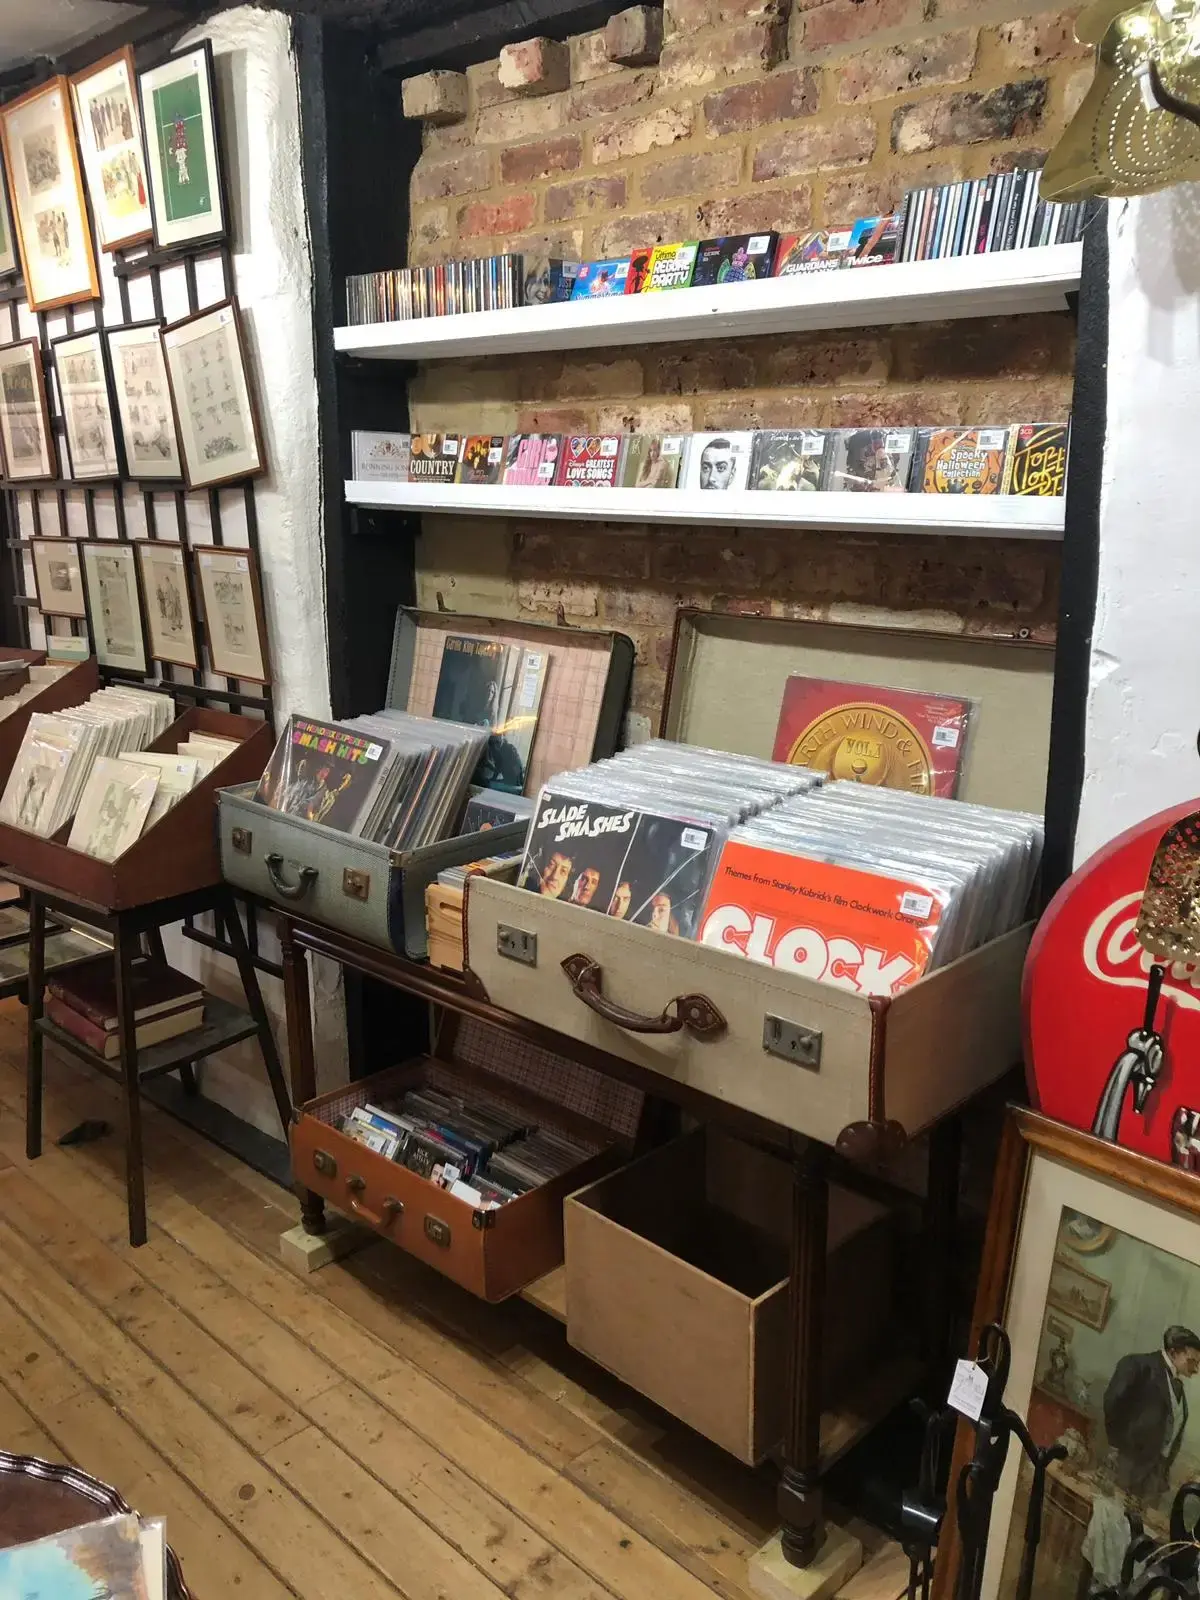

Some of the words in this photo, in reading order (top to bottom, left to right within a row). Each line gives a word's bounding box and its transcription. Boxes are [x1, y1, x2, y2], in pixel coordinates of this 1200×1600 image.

[786, 259, 840, 272] GUARDIANS
[847, 254, 884, 266] Twice
[651, 270, 689, 288] PARTY
[410, 460, 456, 475] COUNTRY
[566, 467, 586, 479] LOVE
[586, 468, 613, 480] SONGS
[937, 460, 985, 470] Halloween
[840, 711, 899, 739] WIND
[896, 738, 913, 757] &
[292, 730, 337, 754] SMASH
[336, 742, 368, 765] HITS
[537, 804, 588, 829] SLADE
[554, 812, 634, 842] SMASHES
[724, 866, 752, 882] Themes
[752, 873, 771, 886] from
[771, 879, 798, 895] Stanley
[799, 886, 832, 903] Kubrick's
[832, 895, 848, 907] Film
[849, 899, 893, 920] Clockwork
